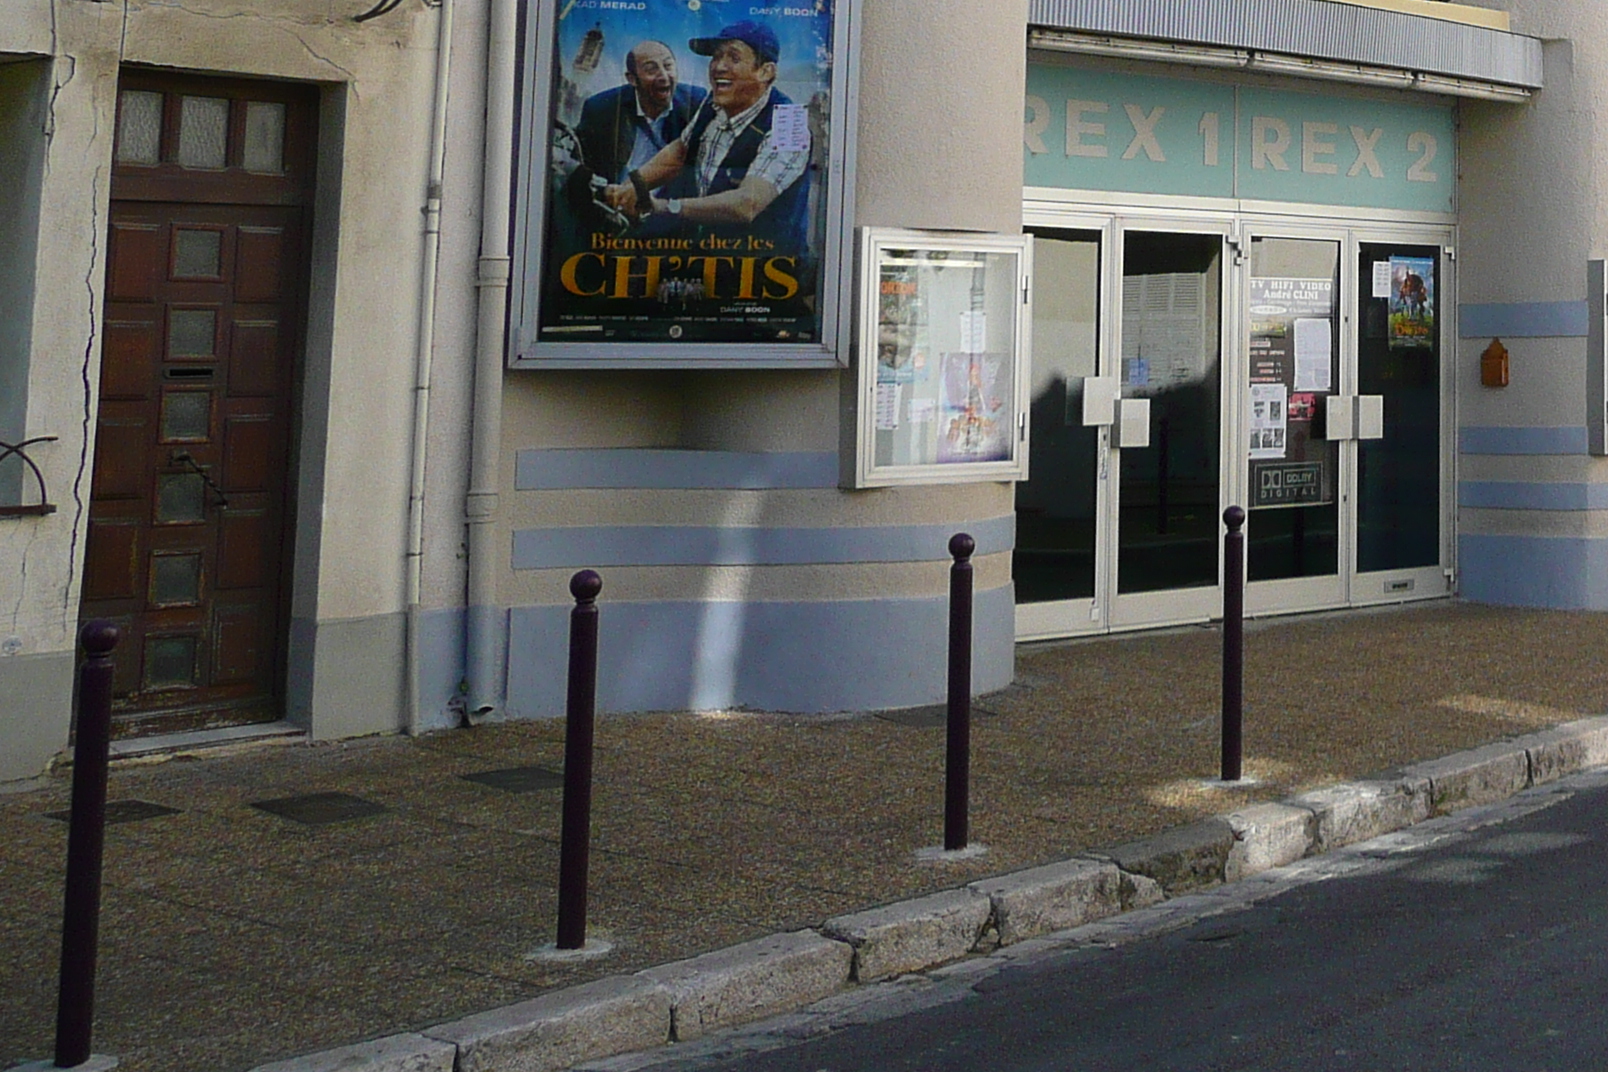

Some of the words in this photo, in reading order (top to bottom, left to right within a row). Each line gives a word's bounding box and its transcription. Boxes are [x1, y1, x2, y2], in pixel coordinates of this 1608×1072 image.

[600, 0, 646, 10] MERAD
[783, 7, 819, 18] BOON
[1023, 95, 1167, 163] REX
[1198, 111, 1219, 167] 1
[1250, 114, 1385, 179] REX
[1406, 131, 1438, 183] 2
[591, 231, 694, 251] Bienvenue
[699, 233, 743, 250] chez
[746, 234, 776, 251] les
[559, 251, 799, 300] CH'TIS
[1250, 280, 1265, 289] TV
[1270, 280, 1294, 290] HIFI
[1299, 281, 1332, 291] VIDEO
[1262, 288, 1292, 299] André
[1293, 290, 1319, 301] CLINI
[1286, 472, 1313, 484] DOLBY
[1260, 485, 1316, 499] DIGITAL
